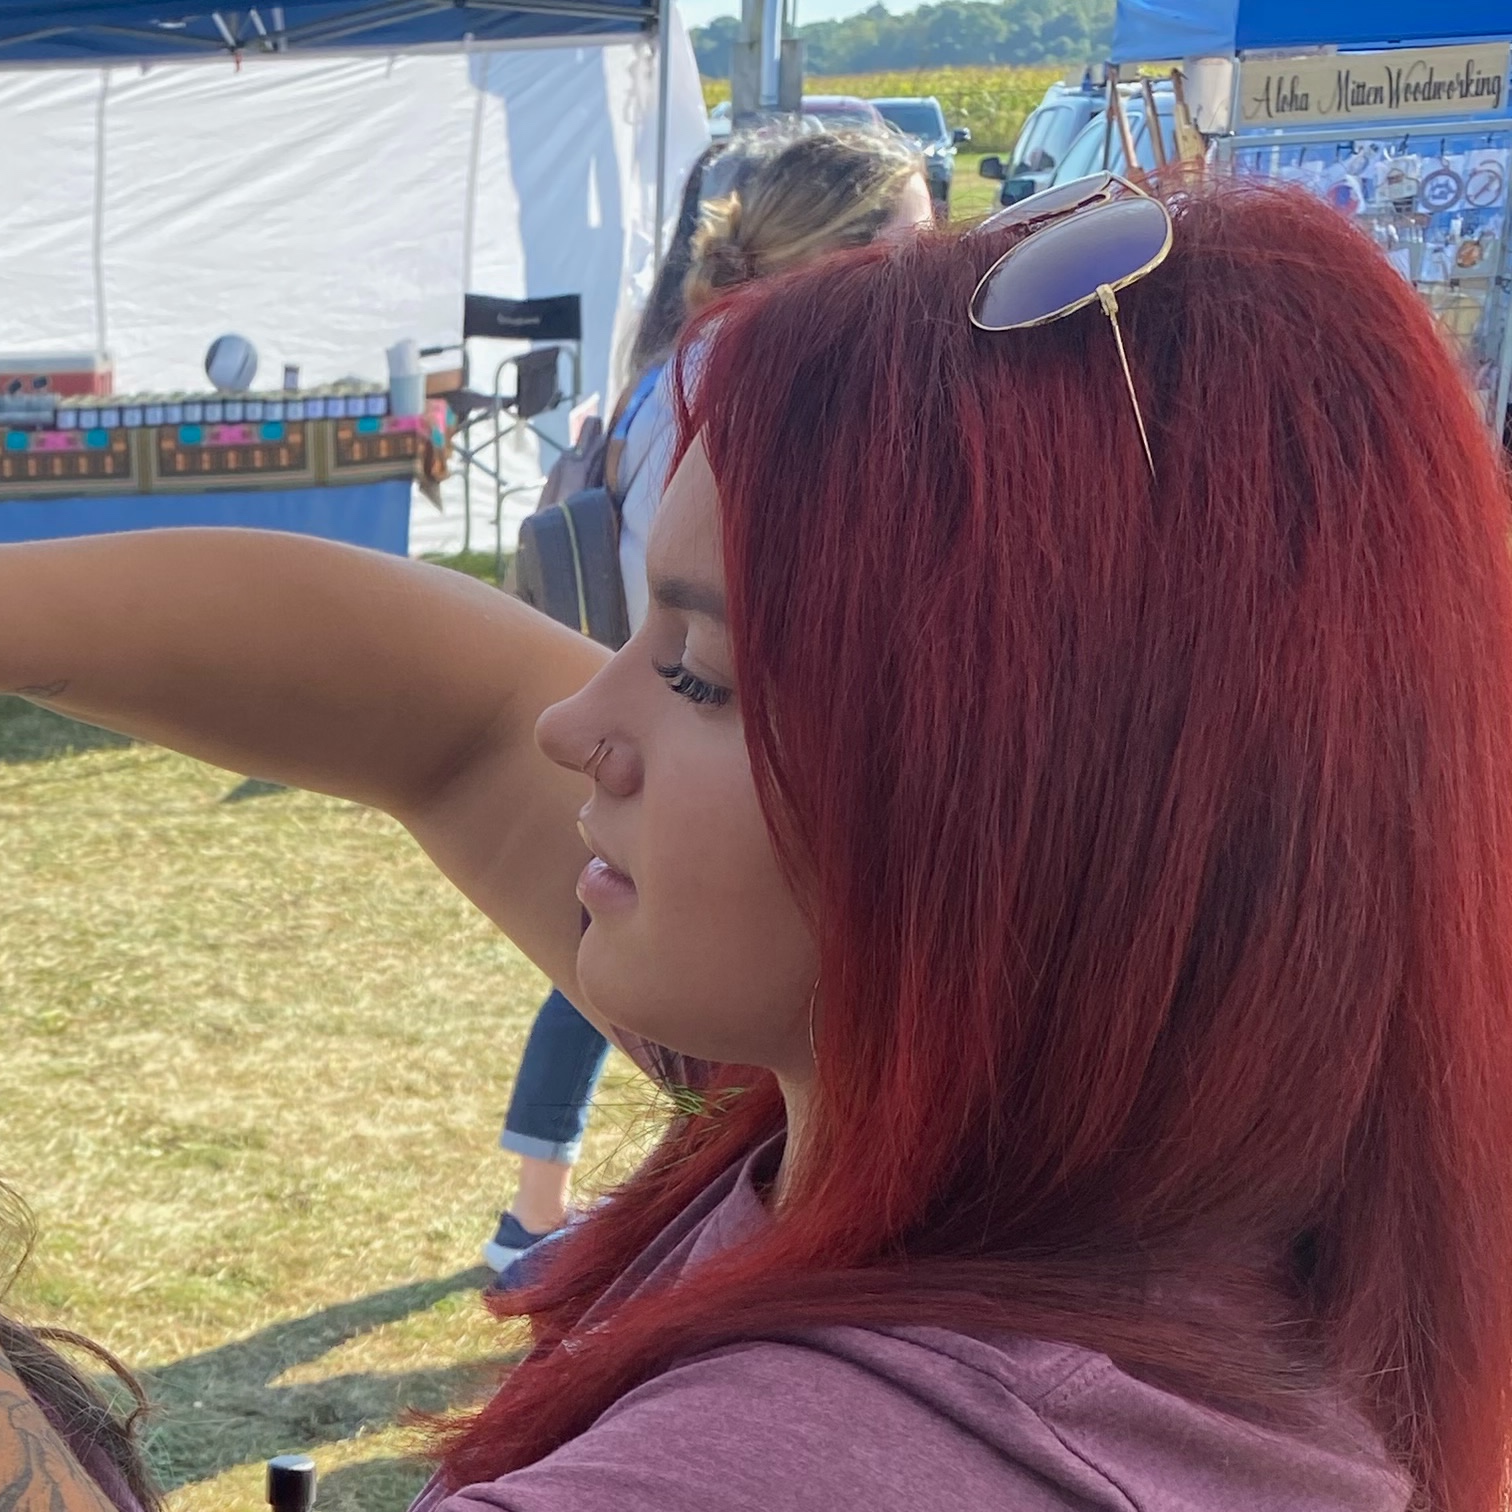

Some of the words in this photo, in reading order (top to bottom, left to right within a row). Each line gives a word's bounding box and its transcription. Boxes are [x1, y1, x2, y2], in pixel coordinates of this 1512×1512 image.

[1241, 74, 1309, 119] Aloha
[1317, 68, 1385, 115] Mitten
[1385, 59, 1502, 110] Woodworking
